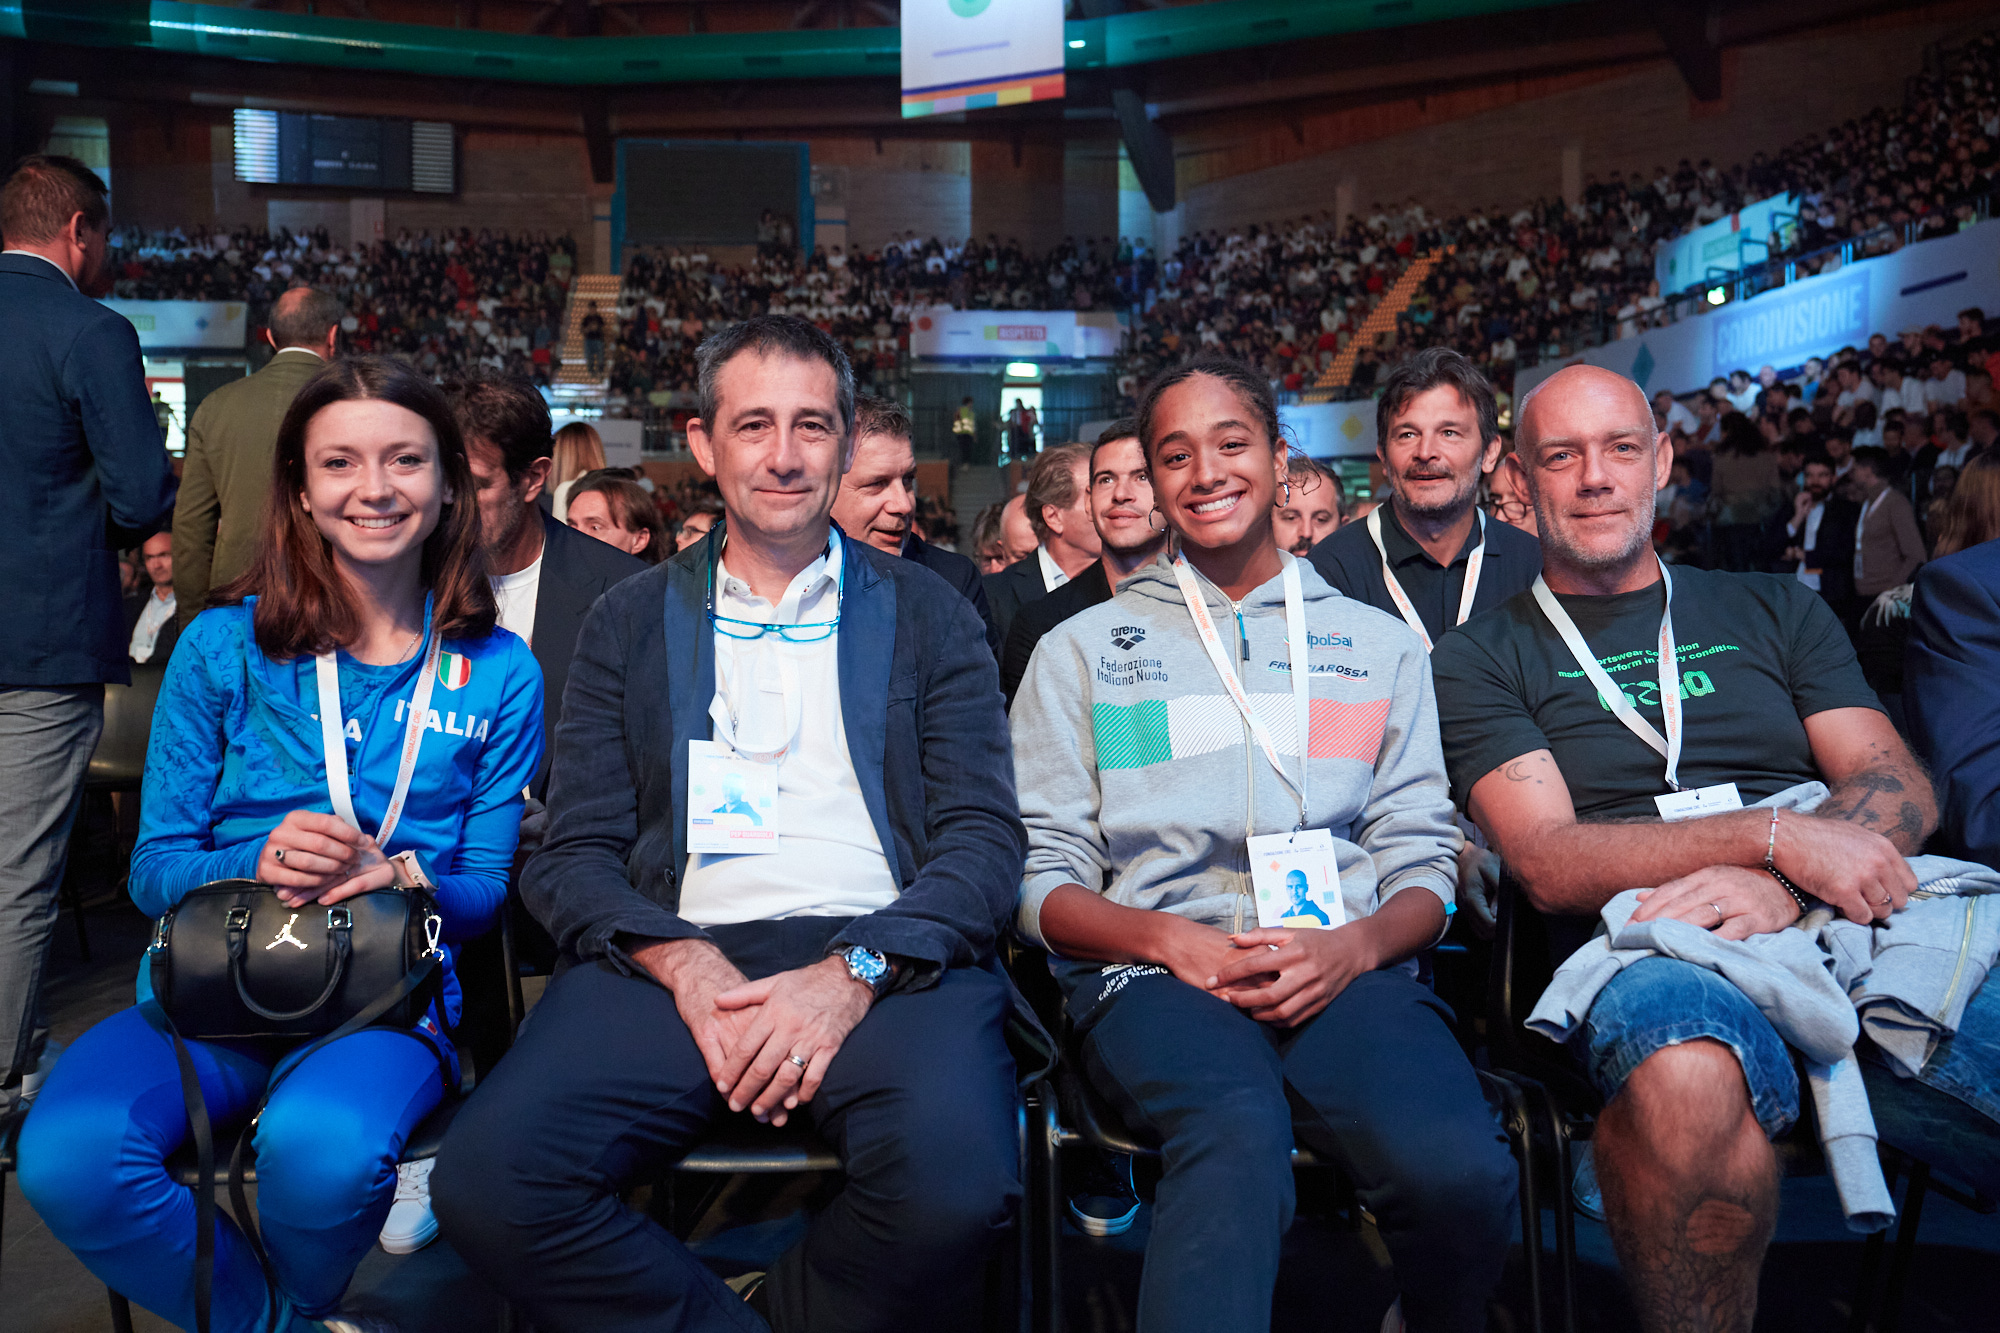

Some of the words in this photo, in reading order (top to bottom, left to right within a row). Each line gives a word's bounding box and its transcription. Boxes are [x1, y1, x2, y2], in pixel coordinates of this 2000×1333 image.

[1716, 283, 1864, 366] CONDIVISIONE
[1189, 594, 1210, 631] FONDAZIONE
[1205, 629, 1216, 643] CRC
[1111, 626, 1146, 637] arena
[1688, 644, 1740, 660] condition
[1101, 656, 1162, 672] Federazione
[1097, 668, 1134, 686] Italiana
[1136, 669, 1168, 682] Nuoto
[1224, 672, 1246, 704] FONDAZIONE
[1666, 693, 1674, 705] CRC
[394, 699, 489, 742] IALIA
[405, 723, 419, 764] FONDAZIONE
[413, 709, 422, 724] CRC
[391, 799, 400, 815] CRC
